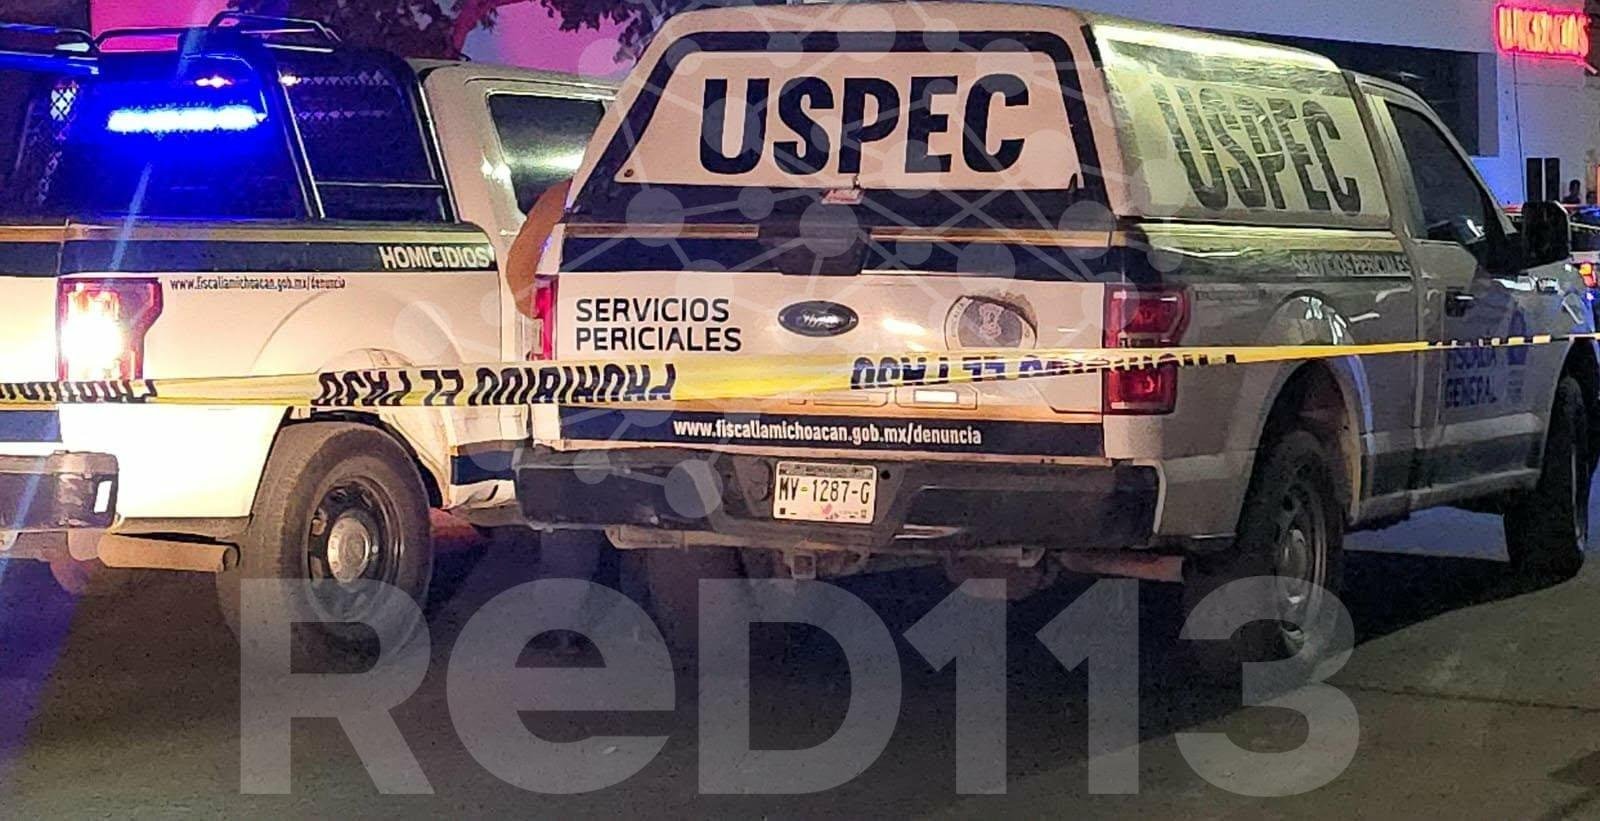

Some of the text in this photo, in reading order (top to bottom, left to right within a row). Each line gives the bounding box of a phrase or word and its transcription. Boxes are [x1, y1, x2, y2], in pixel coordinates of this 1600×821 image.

[700, 74, 1029, 175] USPEC
[1154, 82, 1362, 216] USPEC
[379, 245, 490, 270] HOMICIDIOS
[576, 298, 729, 322] SERVICIOS
[576, 327, 741, 352] PERICIALES
